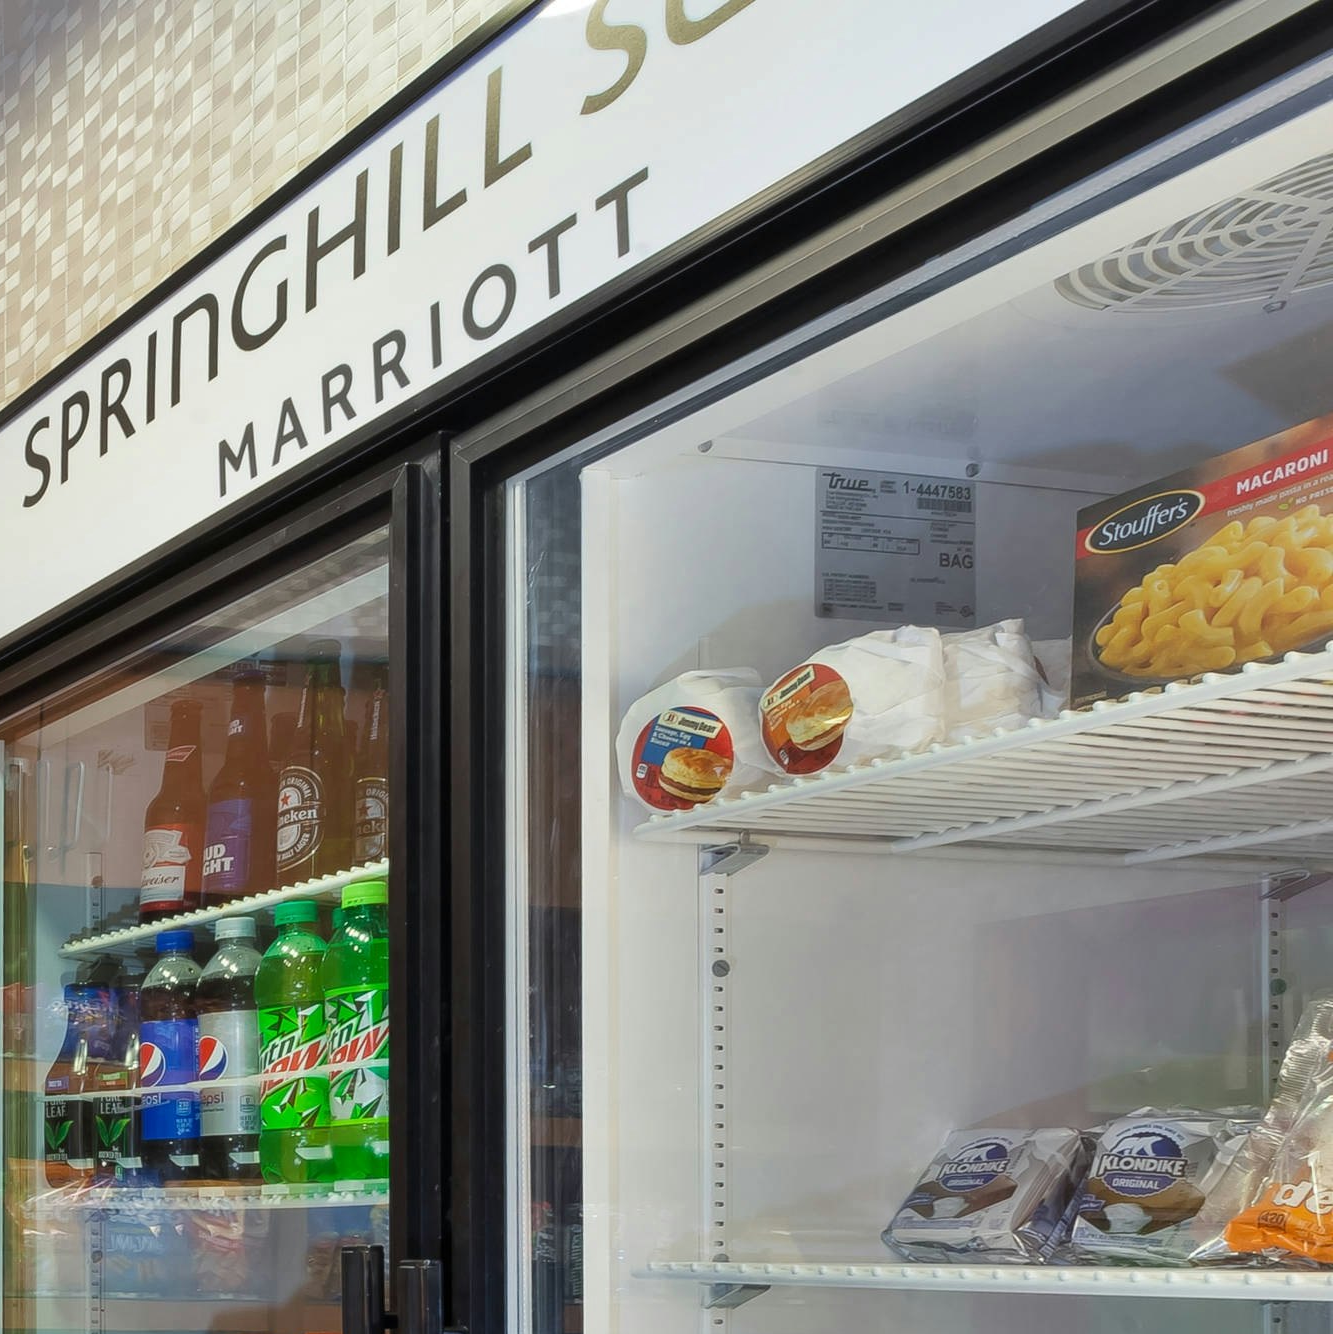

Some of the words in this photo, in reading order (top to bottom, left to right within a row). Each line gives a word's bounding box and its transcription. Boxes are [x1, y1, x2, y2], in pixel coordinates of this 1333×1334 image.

[23, 65, 532, 508] SPRINGHILL
[218, 167, 649, 498] MARRIOTT
[1236, 449, 1329, 495] MACARONI
[903, 481, 971, 500] 1-4447583
[1099, 498, 1189, 546] Stouffer's
[939, 553, 973, 569] BAG
[678, 716, 699, 731] Jimmy
[942, 1159, 1008, 1178] KLONDIKE
[1102, 1154, 1187, 1177] KLONDIKE
[1112, 1178, 1160, 1190] ORIGINAL
